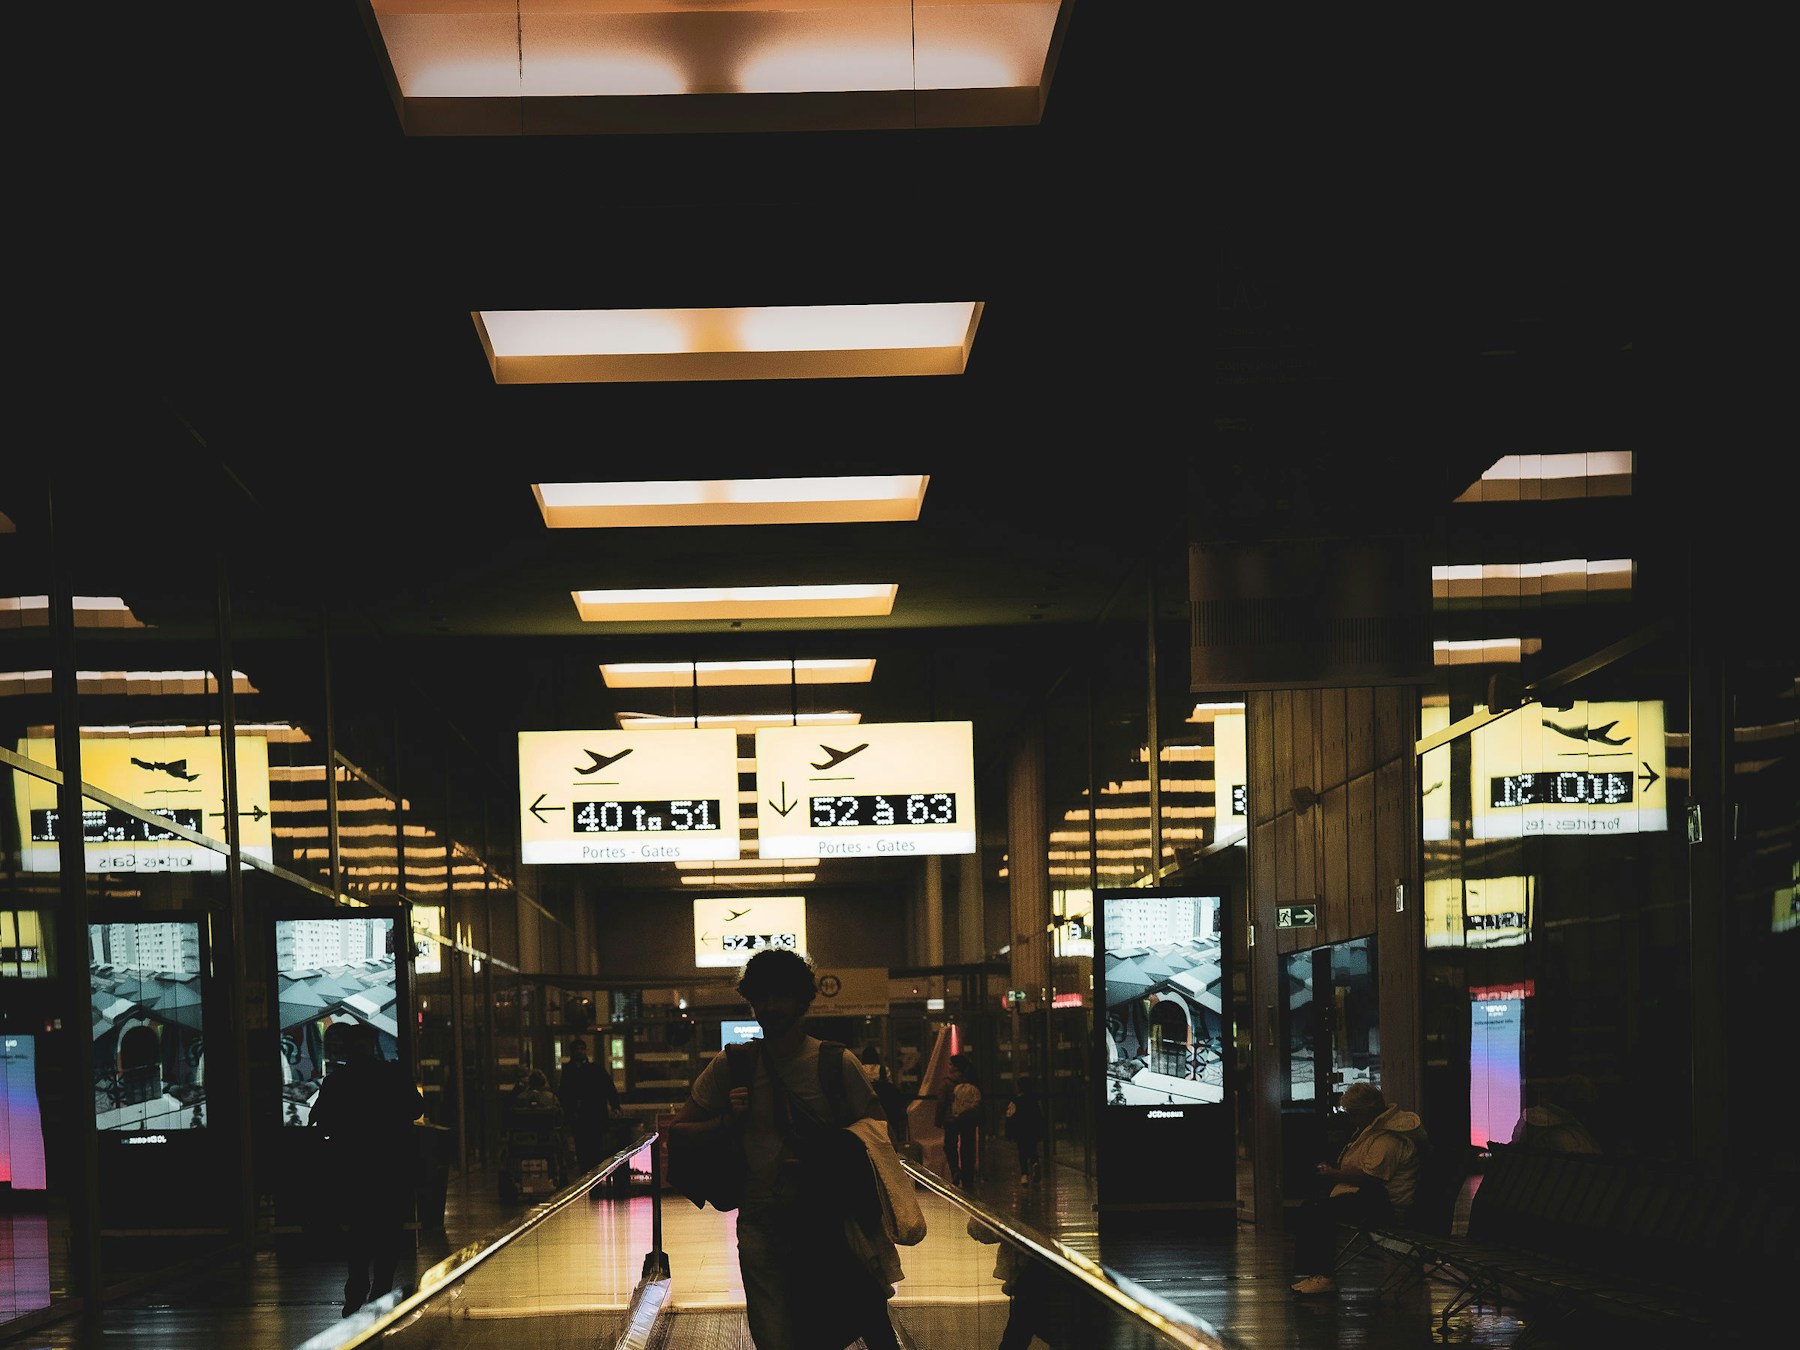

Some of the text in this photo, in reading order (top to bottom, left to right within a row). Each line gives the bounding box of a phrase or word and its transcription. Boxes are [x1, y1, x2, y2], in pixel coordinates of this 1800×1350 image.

[577, 800, 716, 831] 40 to 51
[813, 793, 952, 826] 52 à 63
[582, 846, 626, 859] Portes
[641, 845, 680, 857] Gates
[818, 841, 862, 854] Portes
[876, 839, 916, 852] Gates
[723, 935, 748, 950] 52
[770, 934, 795, 949] 63
